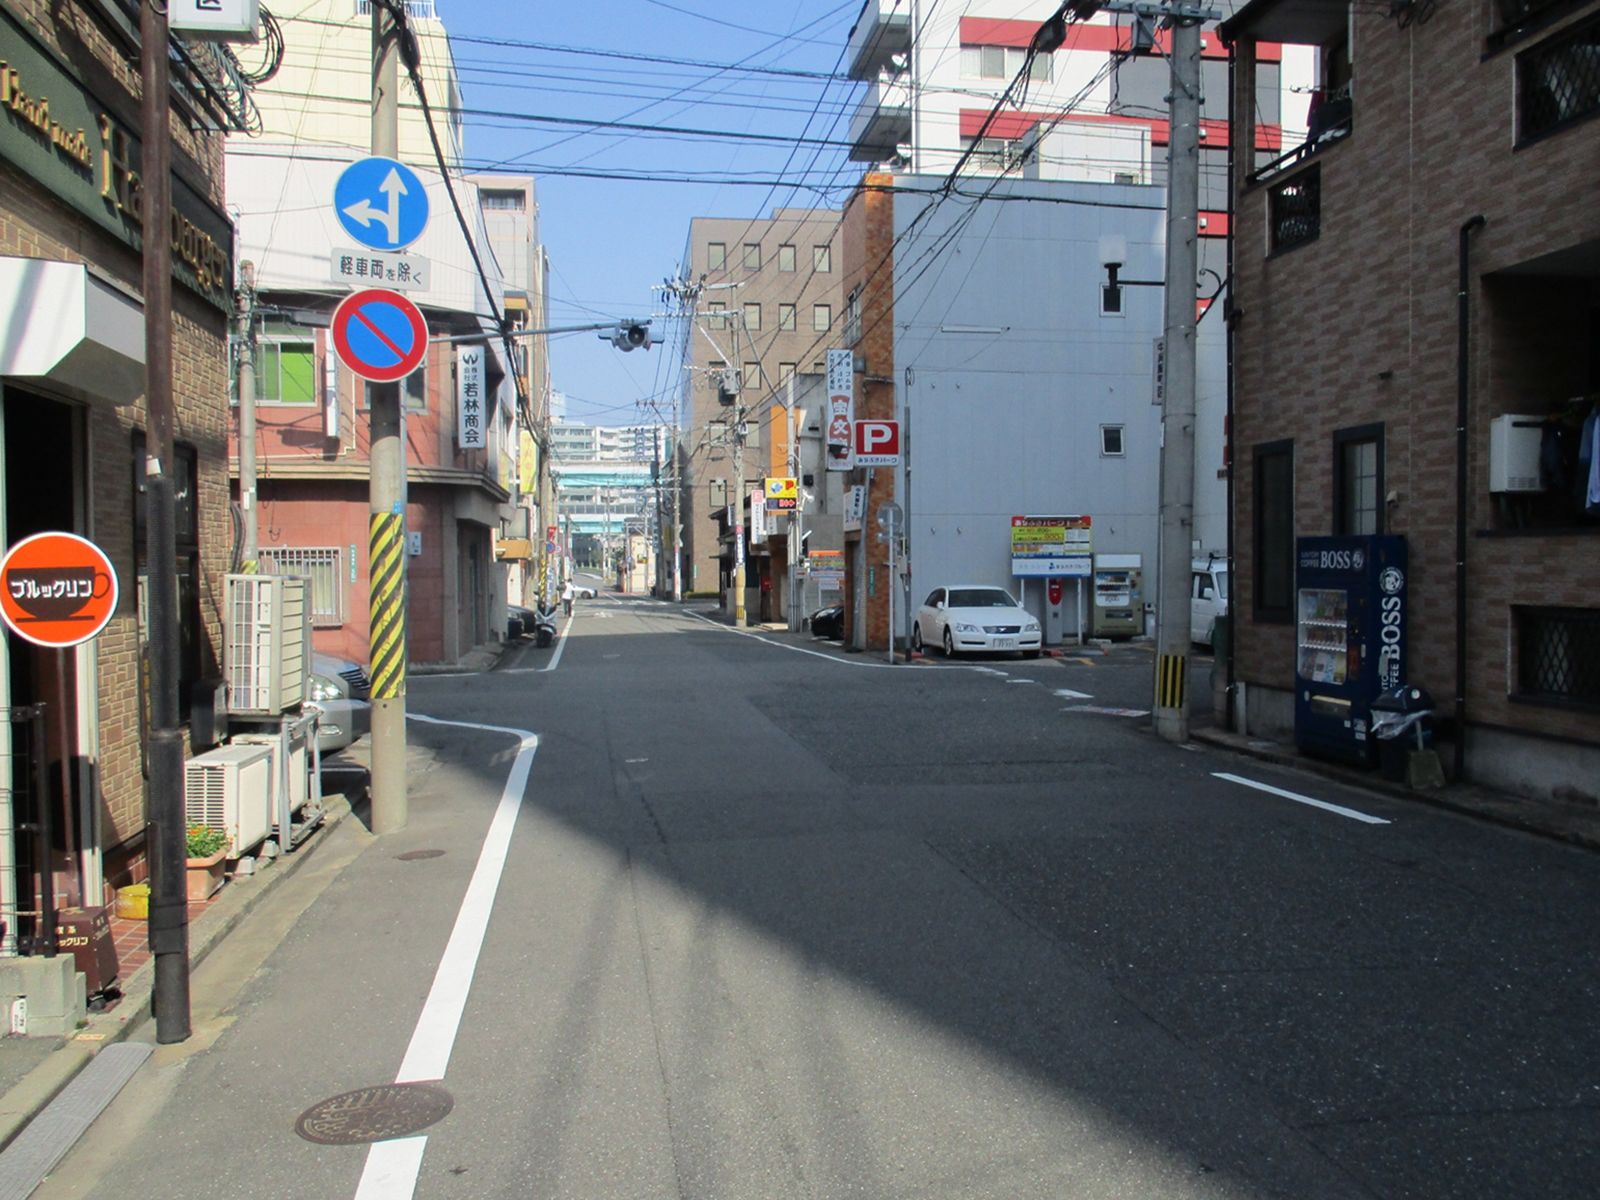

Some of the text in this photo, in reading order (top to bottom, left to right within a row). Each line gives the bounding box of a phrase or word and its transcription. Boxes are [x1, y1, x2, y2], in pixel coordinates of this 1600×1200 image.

[99, 113, 229, 290] Haurger
[340, 255, 422, 285] 軽車両を除く
[464, 383, 480, 444] 若林商会
[863, 424, 893, 453] P
[1321, 551, 1351, 568] BOSS
[10, 578, 93, 599] ブルックリン
[1381, 597, 1401, 660] BOSS
[58, 937, 89, 947] ックリン
